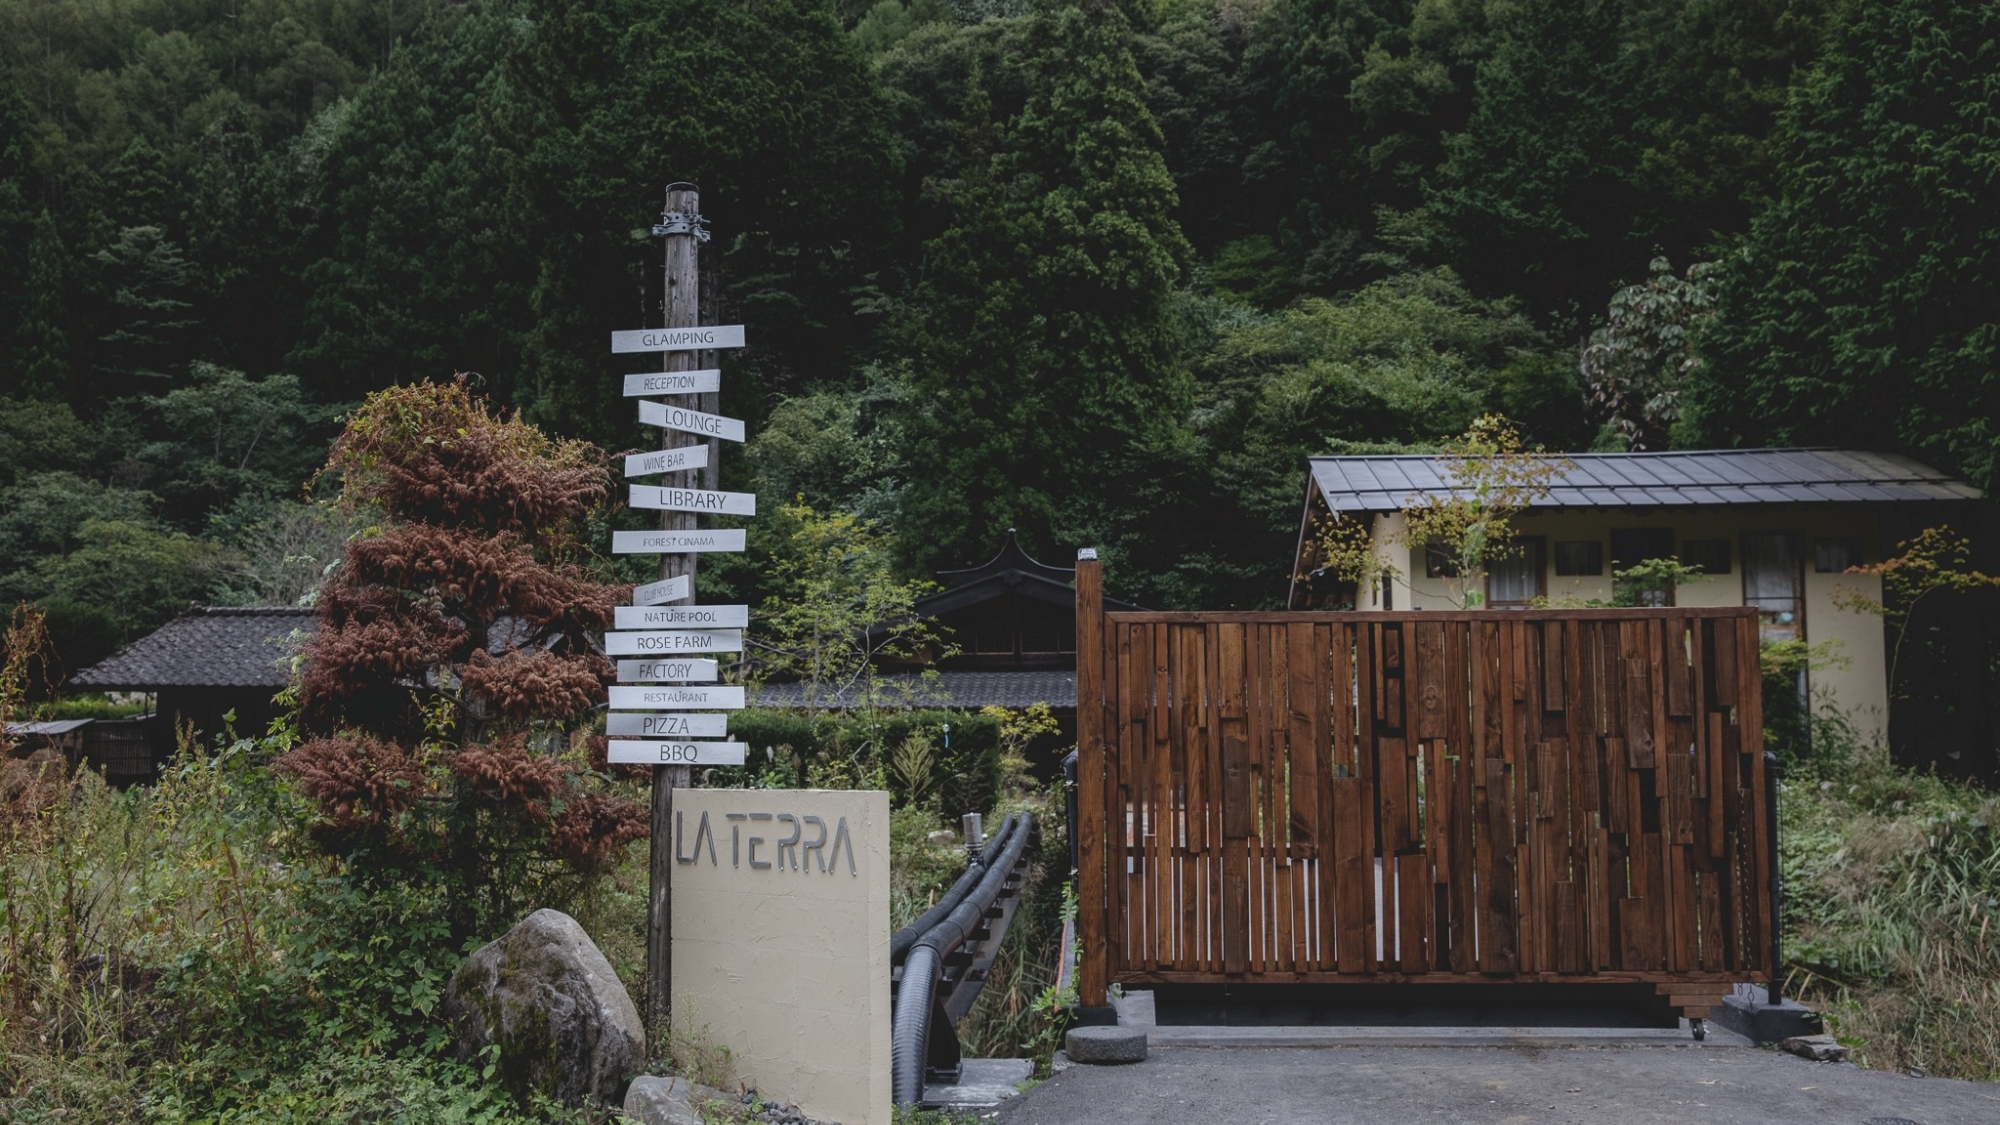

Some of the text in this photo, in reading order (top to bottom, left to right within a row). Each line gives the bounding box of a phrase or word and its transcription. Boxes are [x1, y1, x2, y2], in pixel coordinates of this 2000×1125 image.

[642, 330, 714, 347] GLAMPING
[643, 375, 695, 390] RECEPTION
[665, 408, 722, 435] LOUNGE
[643, 453, 685, 471] WINE BAR
[660, 489, 727, 510] LIBRARY
[643, 536, 715, 547] FOREST CINAMA
[644, 584, 674, 601] CLUB HOUSE
[644, 610, 717, 623] NATURE POOL
[637, 635, 712, 650] ROSE FARM
[639, 663, 692, 679] FACTORY
[644, 692, 708, 703] RESTAURANT
[643, 717, 690, 734] PIZZA
[659, 744, 698, 763] BBQ
[675, 810, 857, 877] LA TERRA
